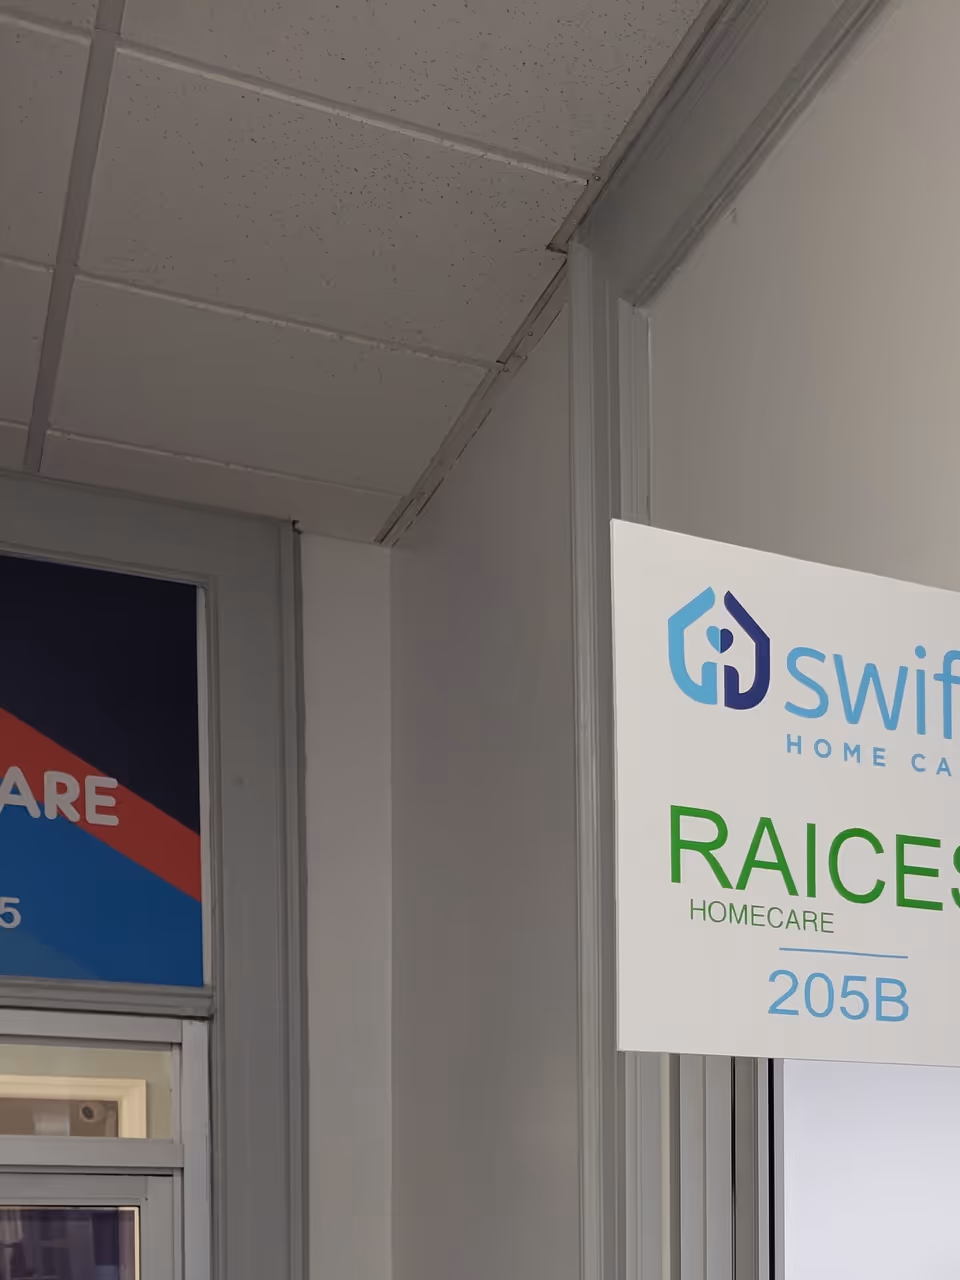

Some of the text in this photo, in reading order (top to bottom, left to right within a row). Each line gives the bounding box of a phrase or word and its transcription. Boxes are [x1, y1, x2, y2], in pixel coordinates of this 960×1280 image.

[786, 734, 886, 767] HOME
[0, 766, 119, 826] ARE
[689, 898, 835, 934] HOMECARE
[767, 969, 909, 1022] 205B
